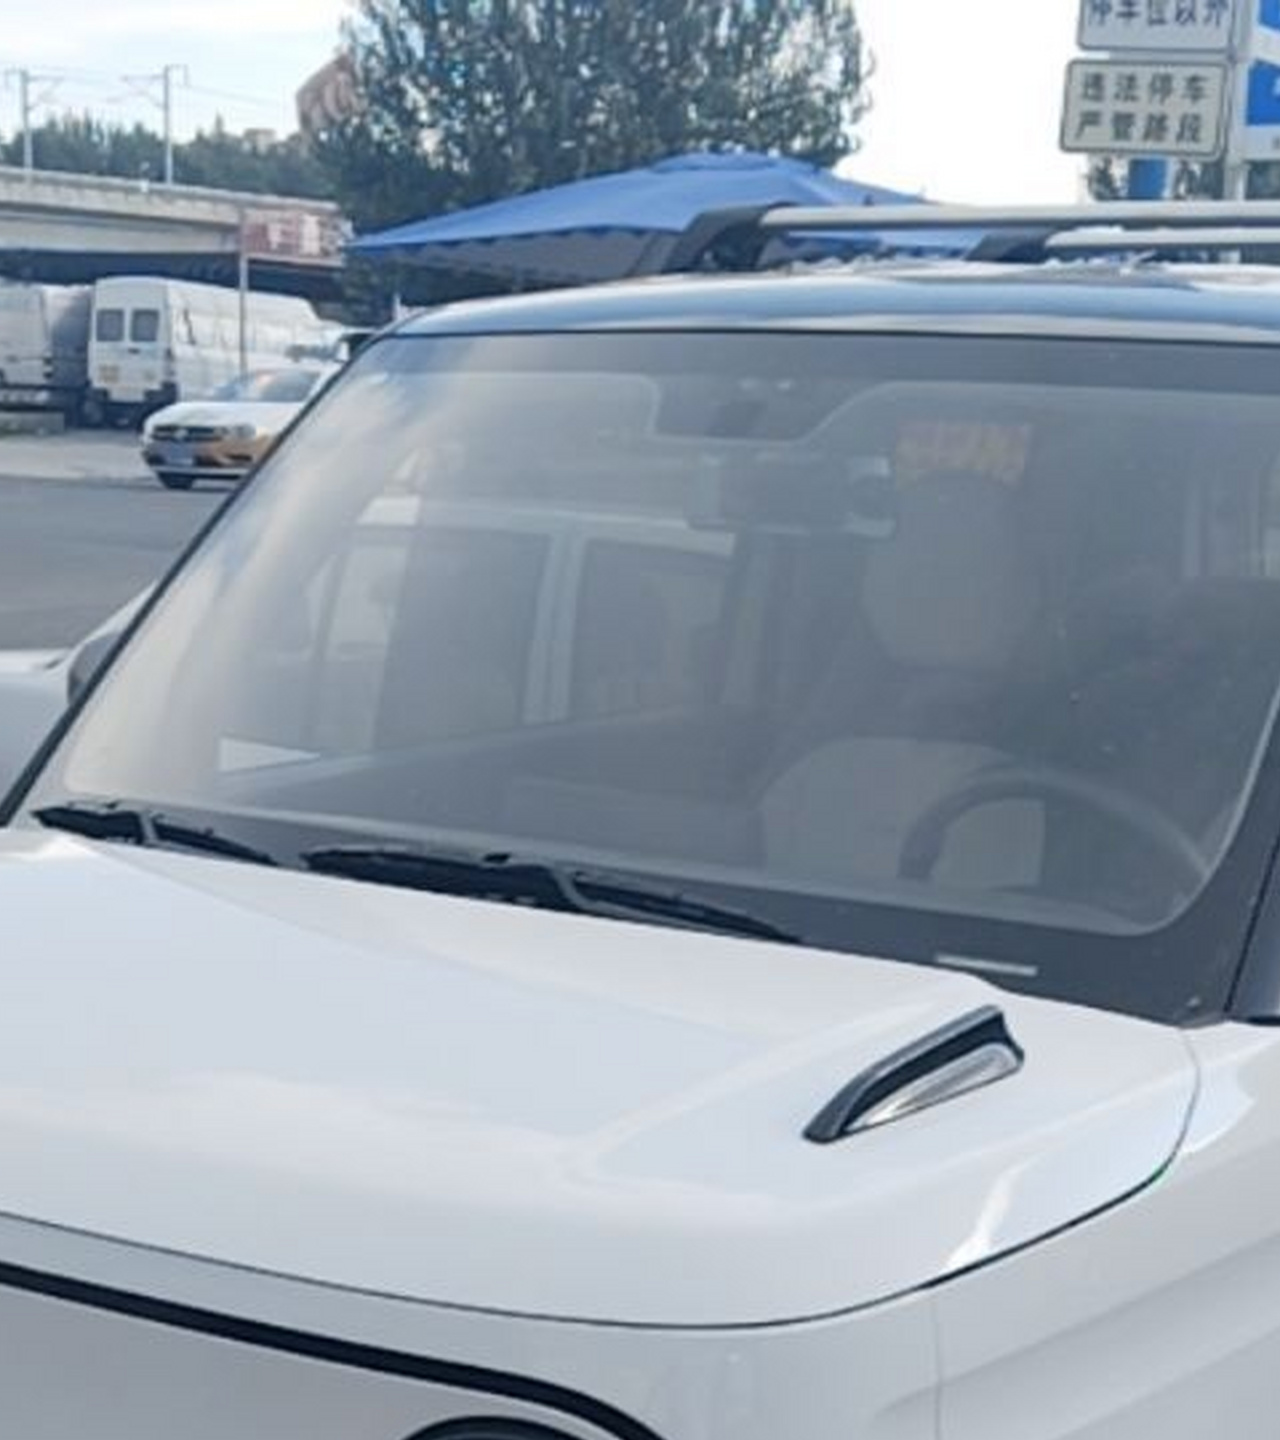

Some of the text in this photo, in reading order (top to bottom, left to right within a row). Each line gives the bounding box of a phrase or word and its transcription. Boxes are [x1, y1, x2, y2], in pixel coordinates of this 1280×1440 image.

[1081, 71, 1211, 105] 违法停车
[1074, 109, 1203, 144] 严管路段
